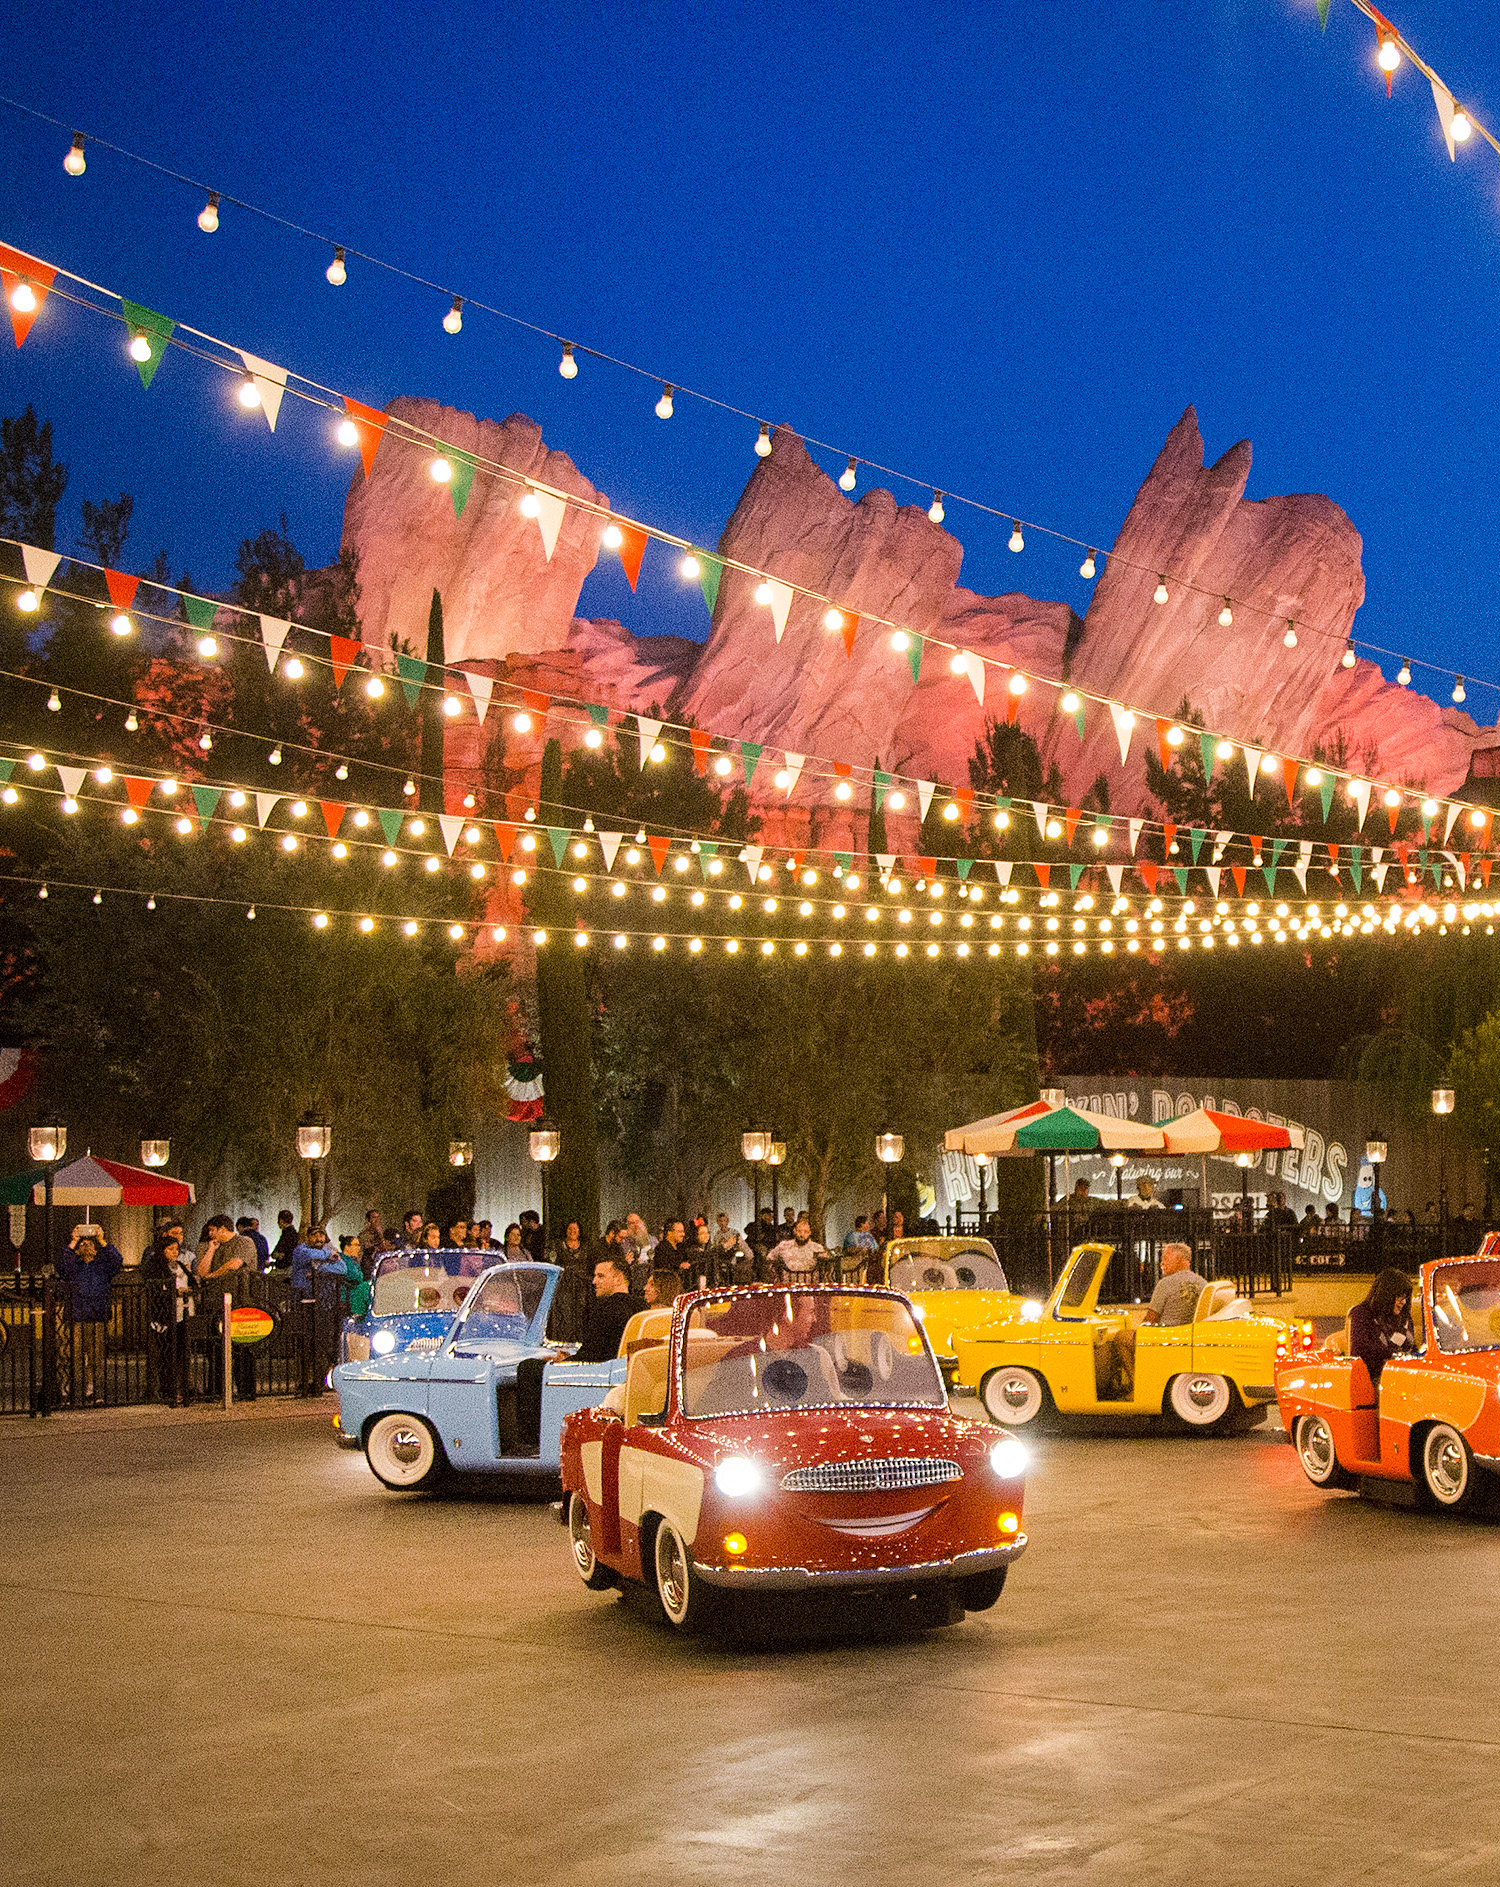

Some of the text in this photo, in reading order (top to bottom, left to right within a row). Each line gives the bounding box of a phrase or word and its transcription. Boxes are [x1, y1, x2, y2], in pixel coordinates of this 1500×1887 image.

[1108, 1164, 1183, 1186] faturing our
[1152, 1090, 1348, 1202] ROSTERS
